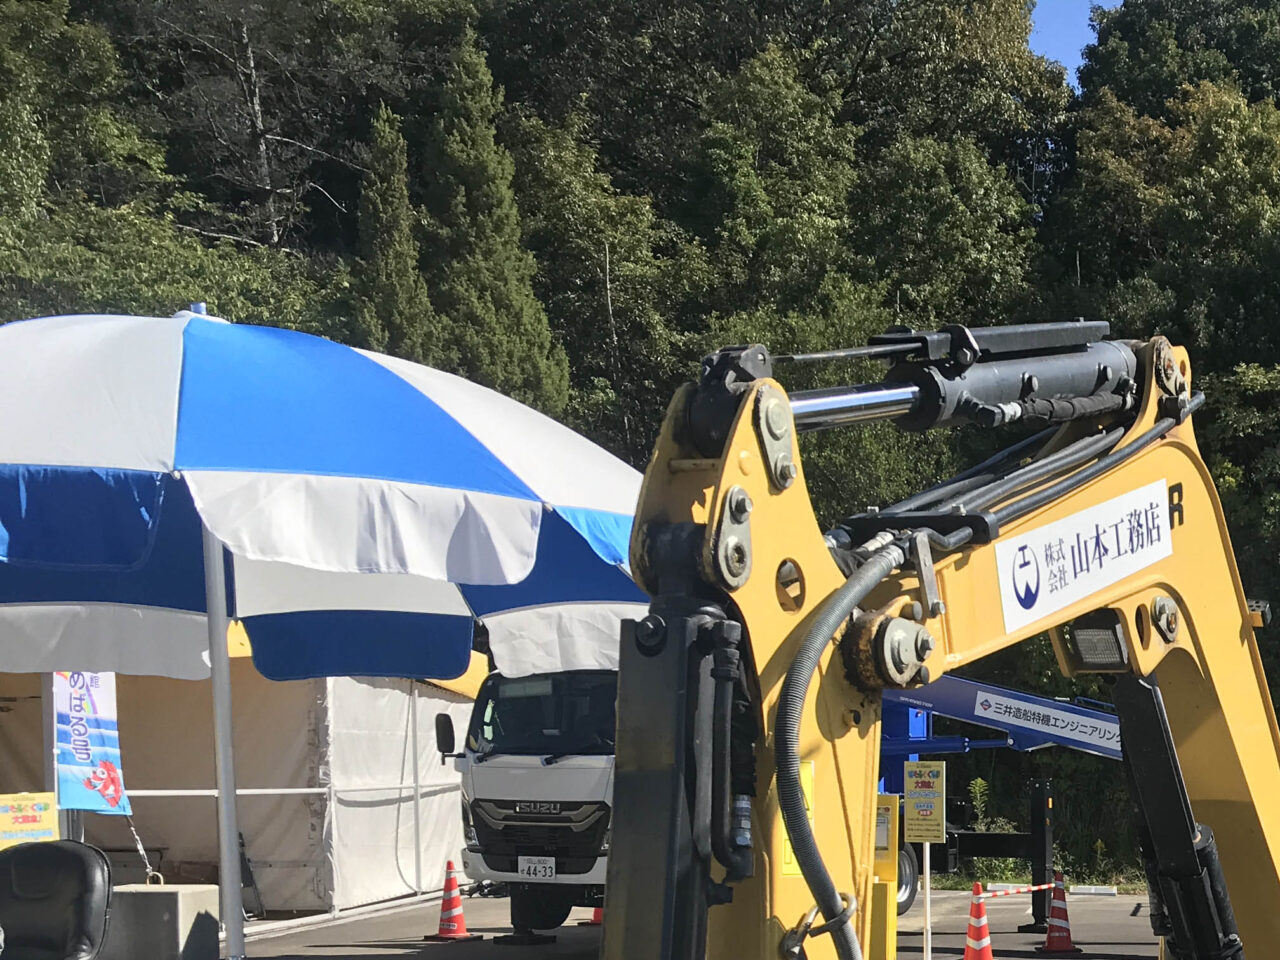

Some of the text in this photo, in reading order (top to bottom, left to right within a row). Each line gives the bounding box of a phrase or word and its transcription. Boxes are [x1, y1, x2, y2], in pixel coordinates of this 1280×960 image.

[1044, 538, 1066, 569] 株式
[1070, 501, 1161, 580] 山本工務店
[1048, 564, 1069, 594] 会社
[516, 803, 560, 813] ISUZU
[526, 865, 554, 878] 44-33
